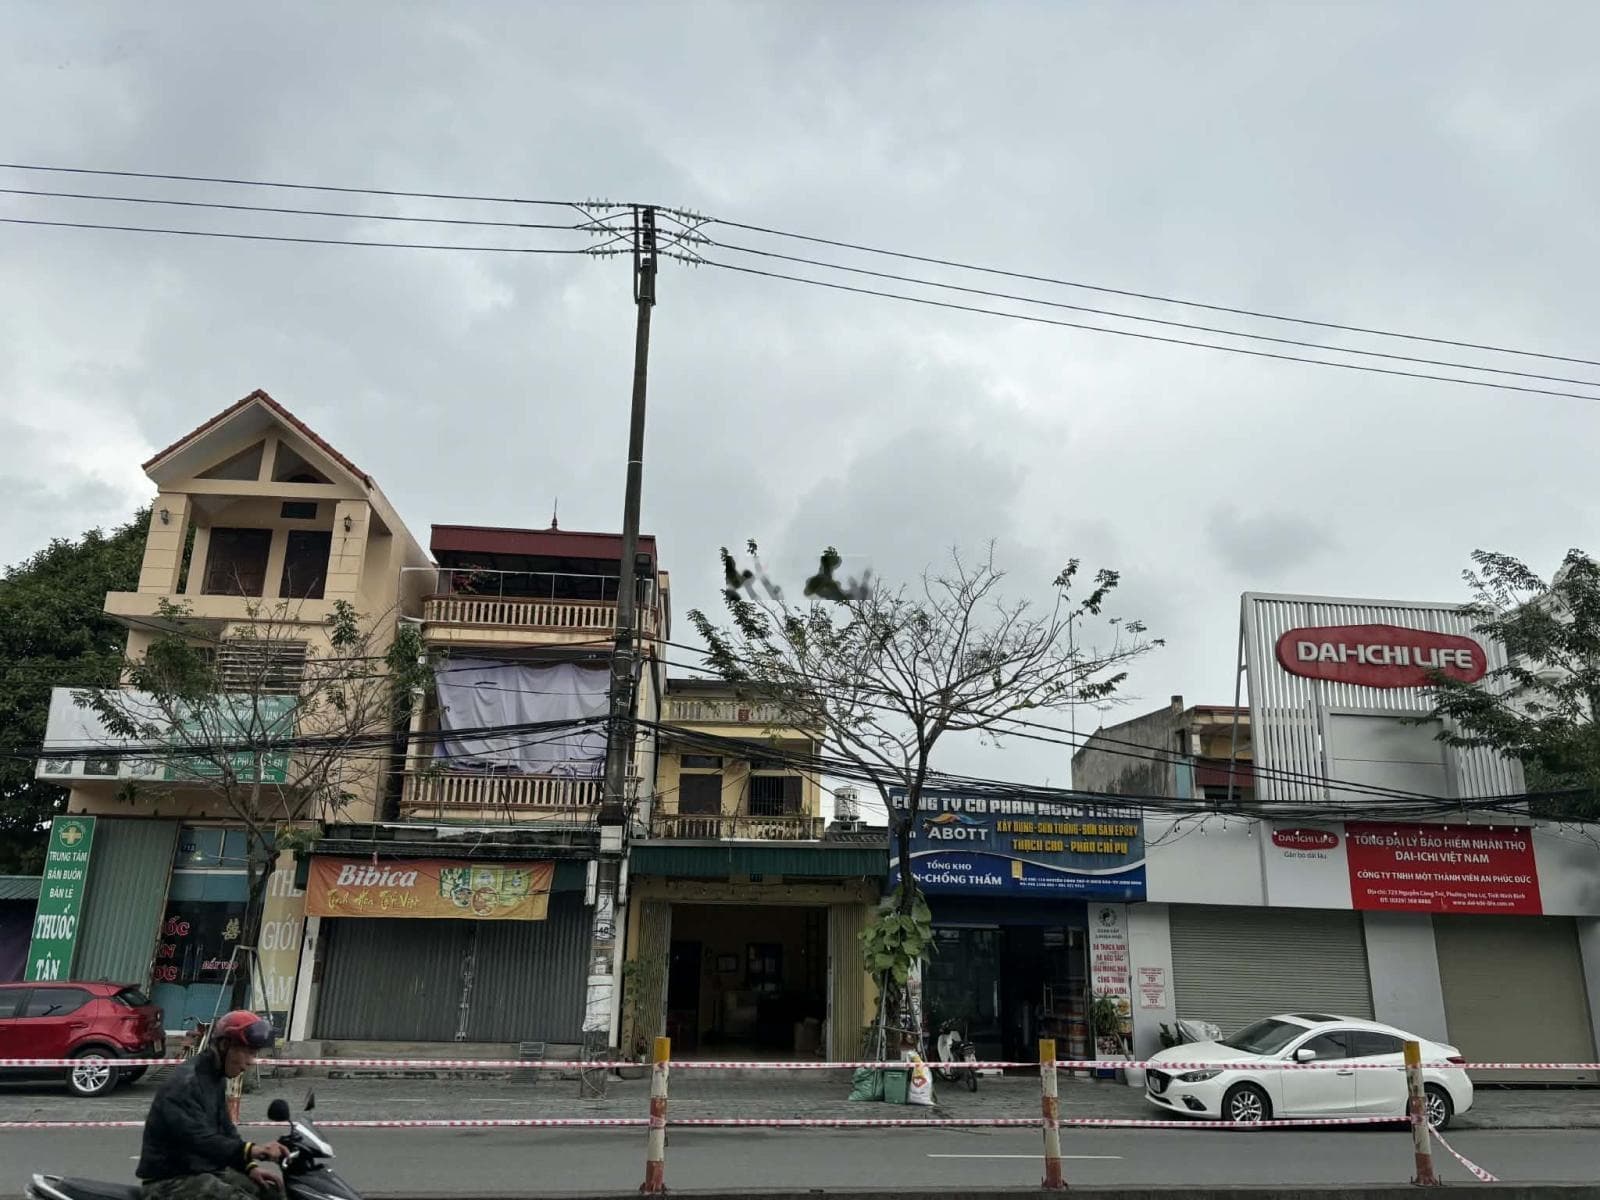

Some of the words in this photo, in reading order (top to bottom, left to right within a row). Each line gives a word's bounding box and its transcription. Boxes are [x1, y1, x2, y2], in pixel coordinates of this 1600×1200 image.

[1297, 641, 1410, 666] DAI-ICHI
[1413, 645, 1473, 669] LIFE
[941, 798, 962, 811] TY
[927, 827, 988, 840] ABOTT
[1421, 834, 1442, 848] BẢO
[1504, 840, 1526, 852] THỌ
[49, 851, 70, 861] TRUNG
[72, 850, 87, 861] TÂM
[1395, 850, 1438, 862] DAI-ICHI
[1440, 850, 1462, 864] VIỆT
[1464, 853, 1489, 863] NAM
[927, 858, 951, 870] TỔNG
[953, 863, 972, 871] KHO
[47, 869, 61, 879] BÁN
[337, 864, 418, 887] Bibica
[1357, 868, 1380, 879] CÔNG
[1392, 872, 1413, 881] TNHH
[1415, 871, 1433, 882] MỘT
[1481, 874, 1492, 883] AN
[49, 887, 63, 898] BÁN
[35, 904, 75, 940] THUỐC
[262, 913, 300, 951] GIỚI
[35, 951, 60, 980] TÂN
